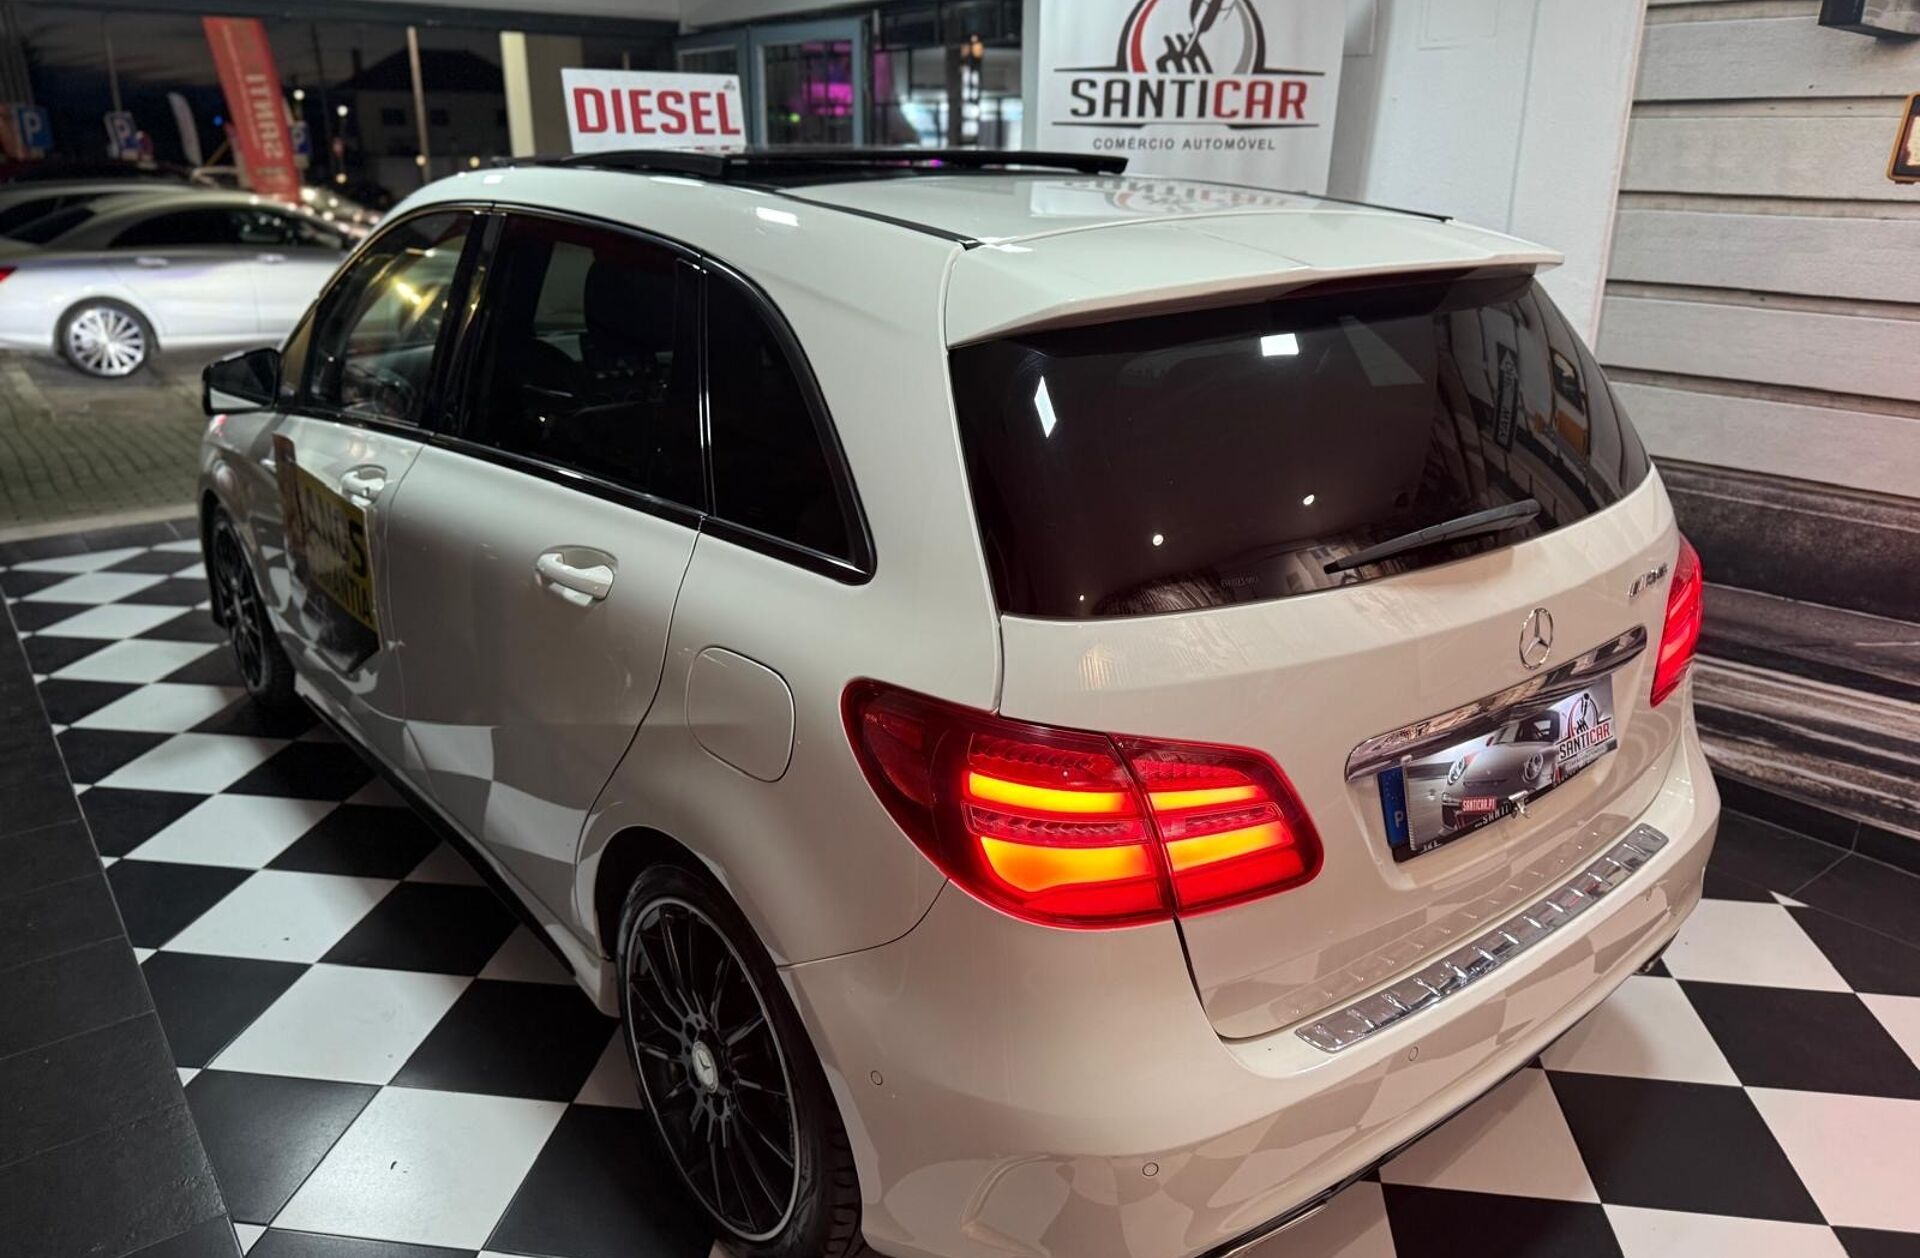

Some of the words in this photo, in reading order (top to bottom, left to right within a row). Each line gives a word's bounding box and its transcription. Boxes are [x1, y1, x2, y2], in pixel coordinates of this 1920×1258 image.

[573, 87, 741, 136] DIESEL
[1069, 78, 1308, 120] SANTICAR
[23, 111, 43, 145] P
[1093, 136, 1174, 151] COMÉRCIO
[1182, 136, 1275, 151] AUTOMÓVEL
[1559, 723, 1610, 759] SANTICAR
[1394, 810, 1405, 828] P
